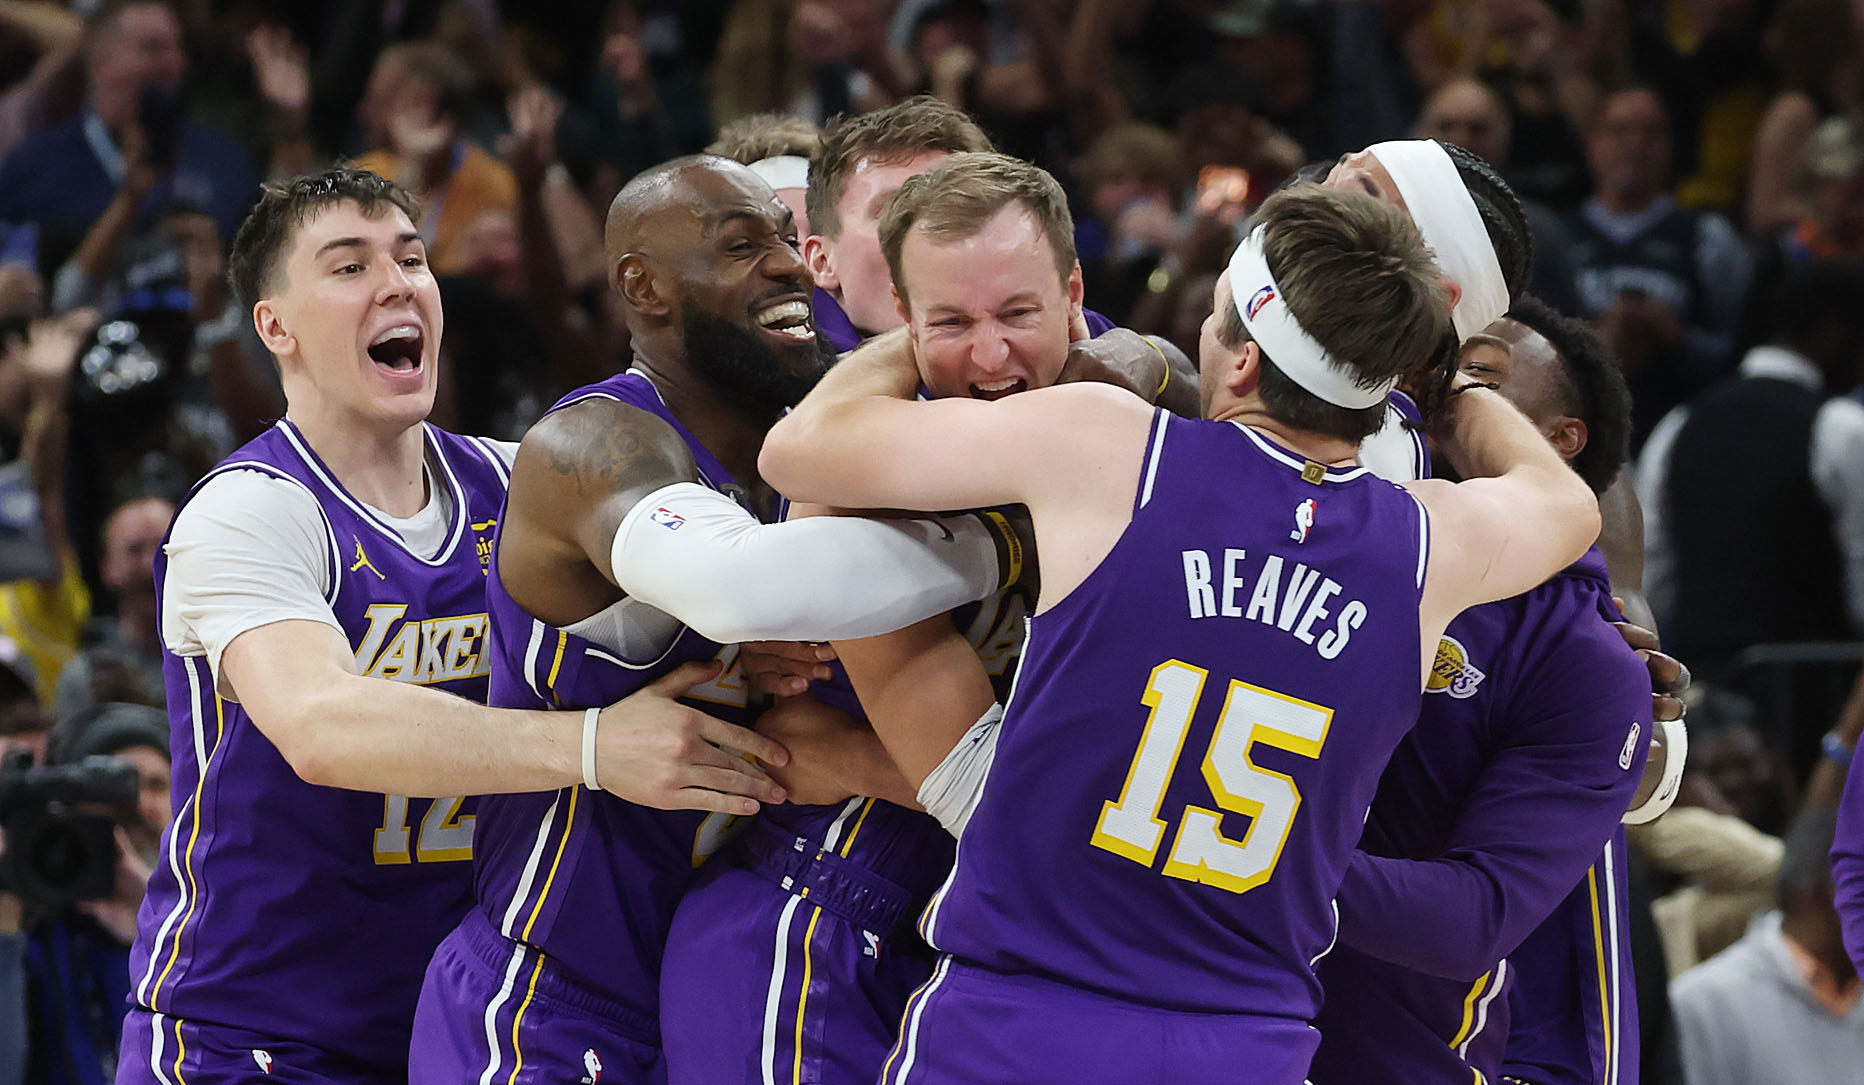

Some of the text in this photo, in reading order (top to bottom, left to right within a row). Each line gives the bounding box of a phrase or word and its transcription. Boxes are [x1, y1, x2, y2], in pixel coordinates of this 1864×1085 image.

[1182, 548, 1368, 660] REAVES
[373, 793, 477, 865] 12
[1090, 658, 1336, 895] 15
